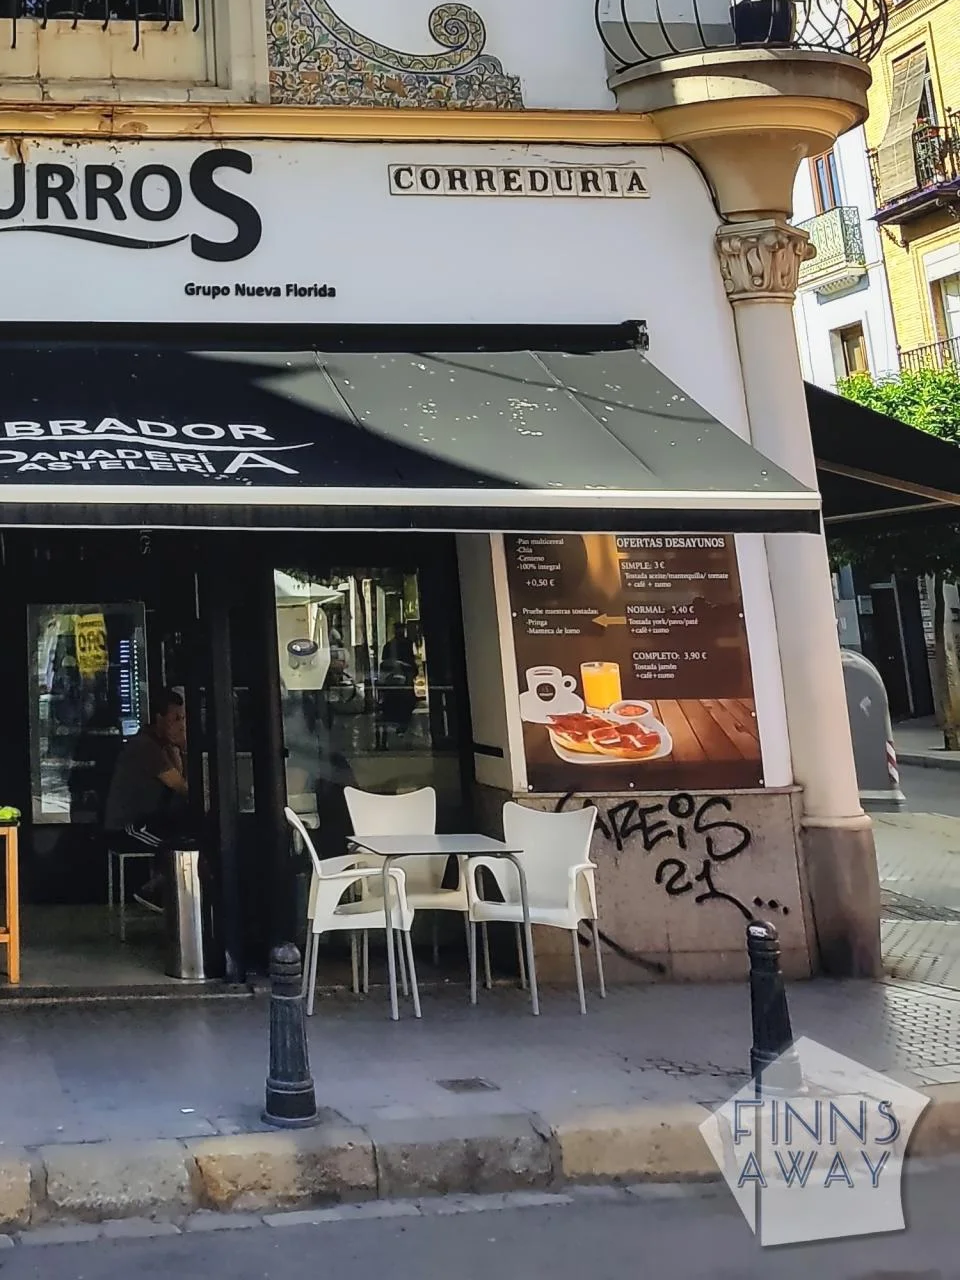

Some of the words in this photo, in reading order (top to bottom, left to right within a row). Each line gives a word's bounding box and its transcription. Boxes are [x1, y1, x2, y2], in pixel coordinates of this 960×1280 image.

[393, 167, 646, 193] CORREDURIA
[184, 283, 230, 299] Grupo
[235, 284, 281, 297] Nueva
[286, 284, 337, 298] Florida
[617, 538, 662, 548] OFERTAS
[665, 538, 725, 548] DESAYUNOS
[621, 562, 652, 570] SIMPLE:
[654, 561, 659, 569] 3
[660, 561, 665, 569] €
[549, 579, 555, 587] €
[627, 606, 666, 614] NORMAL:
[633, 652, 680, 660] COMPLETO:
[701, 652, 707, 660] €
